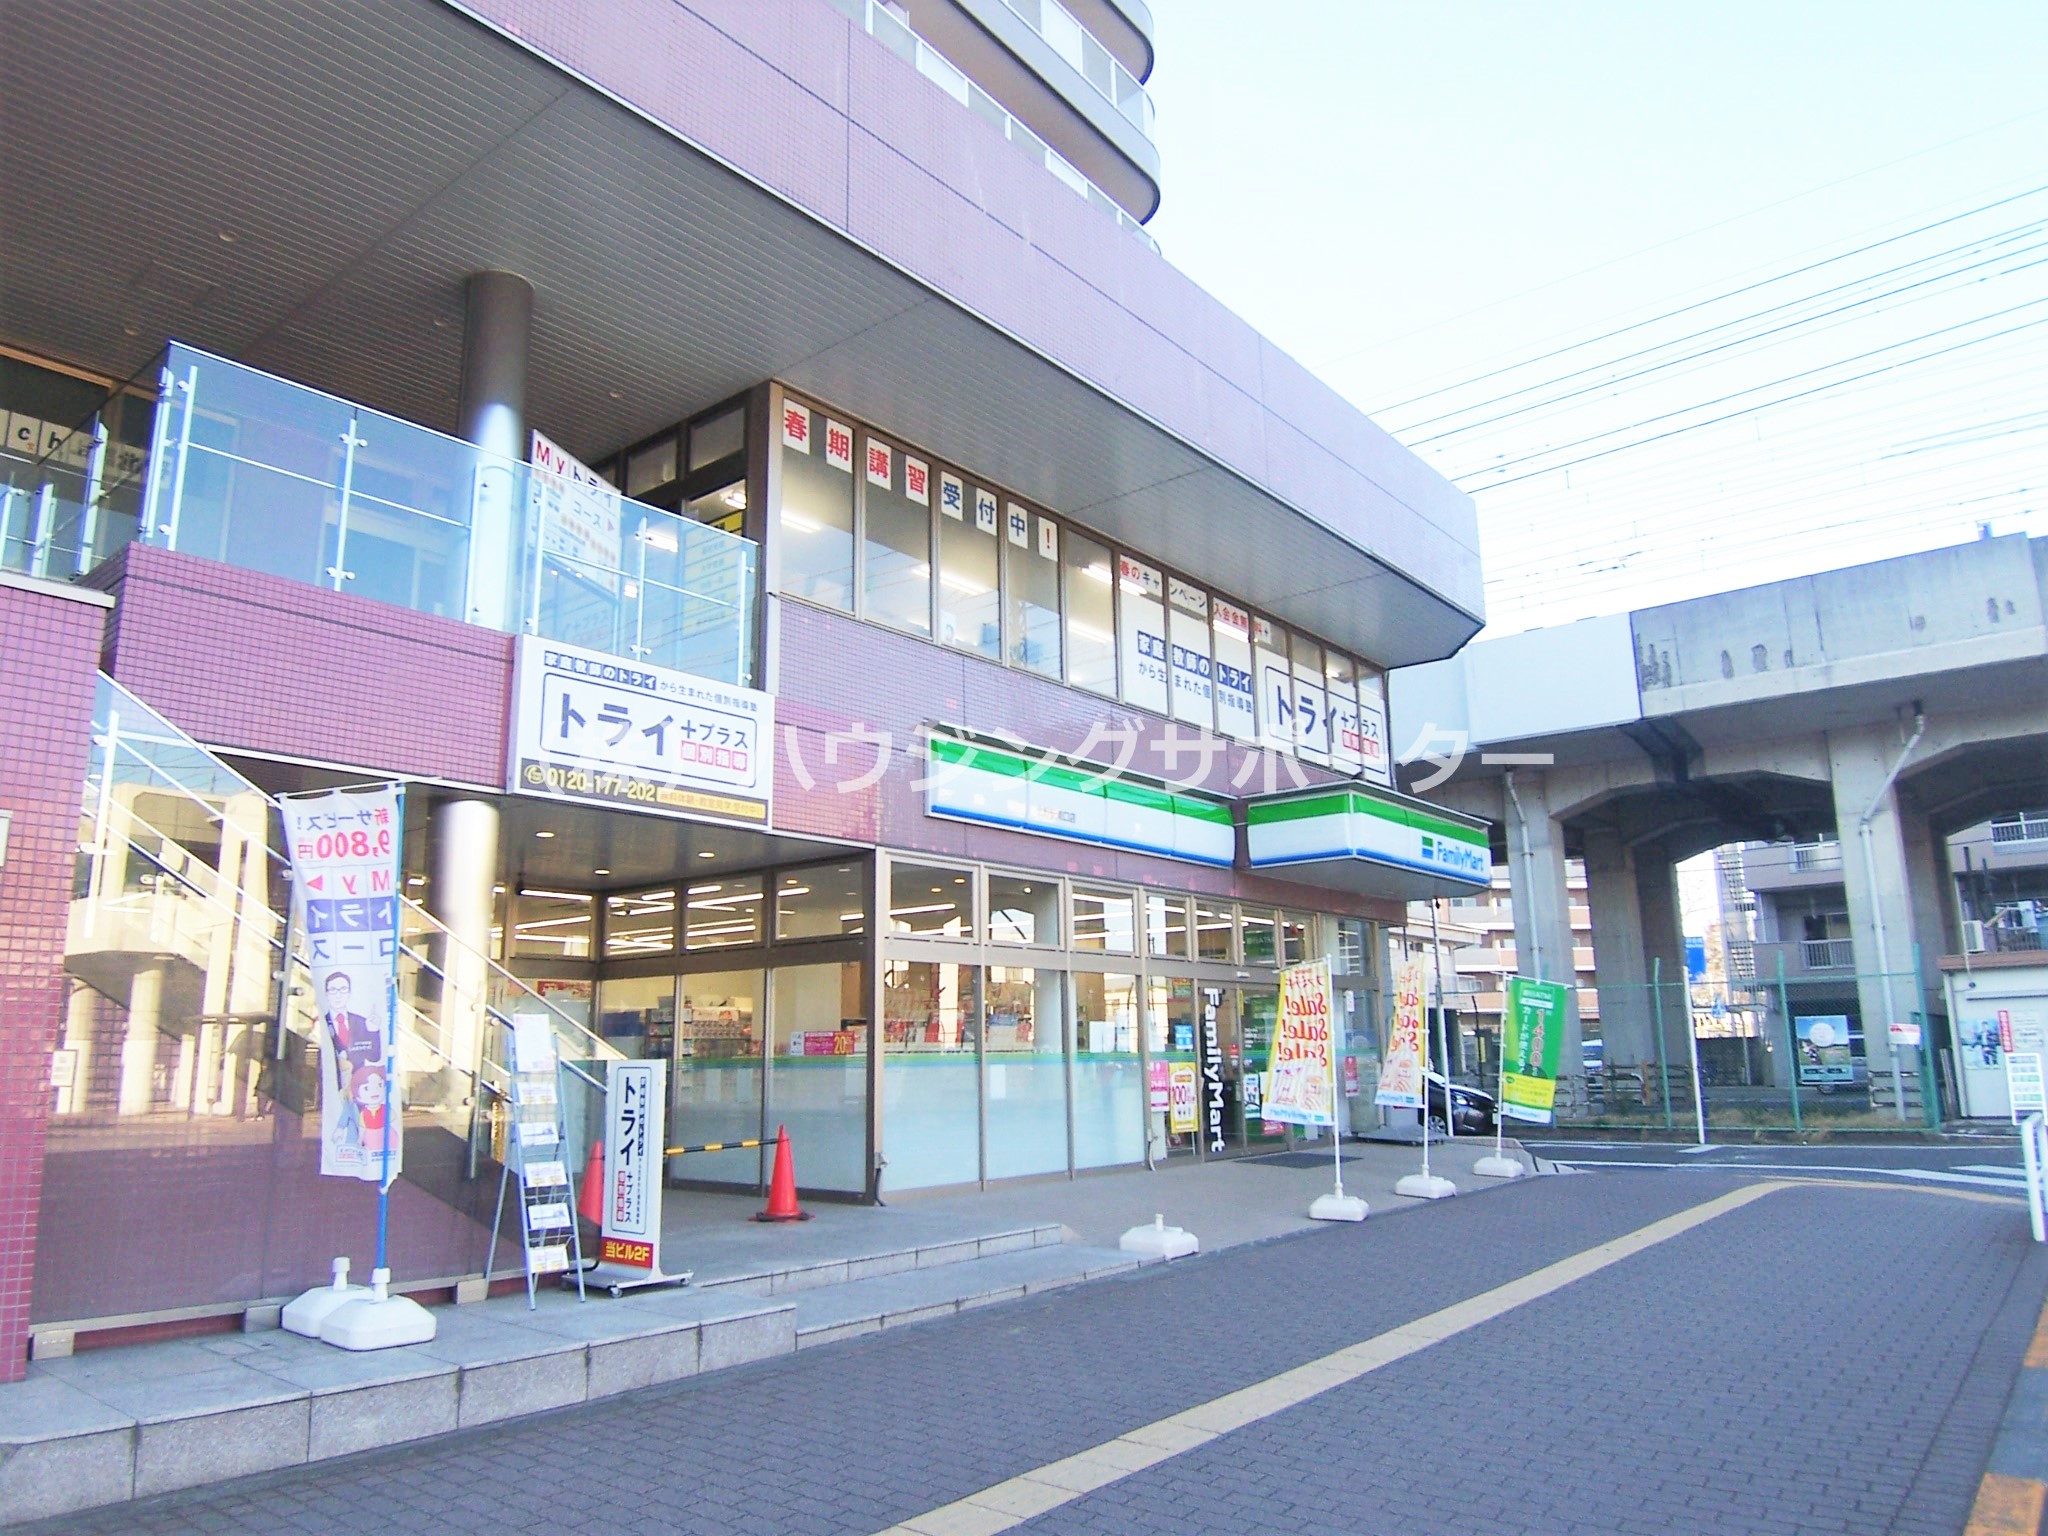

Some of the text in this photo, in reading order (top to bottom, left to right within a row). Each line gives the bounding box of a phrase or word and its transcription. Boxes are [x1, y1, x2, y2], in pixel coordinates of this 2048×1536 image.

[560, 693, 674, 756] トライ
[547, 768, 656, 802] 0120-177-202
[1437, 841, 1484, 872] FamilyMart
[1203, 987, 1226, 1153] FamilyMart
